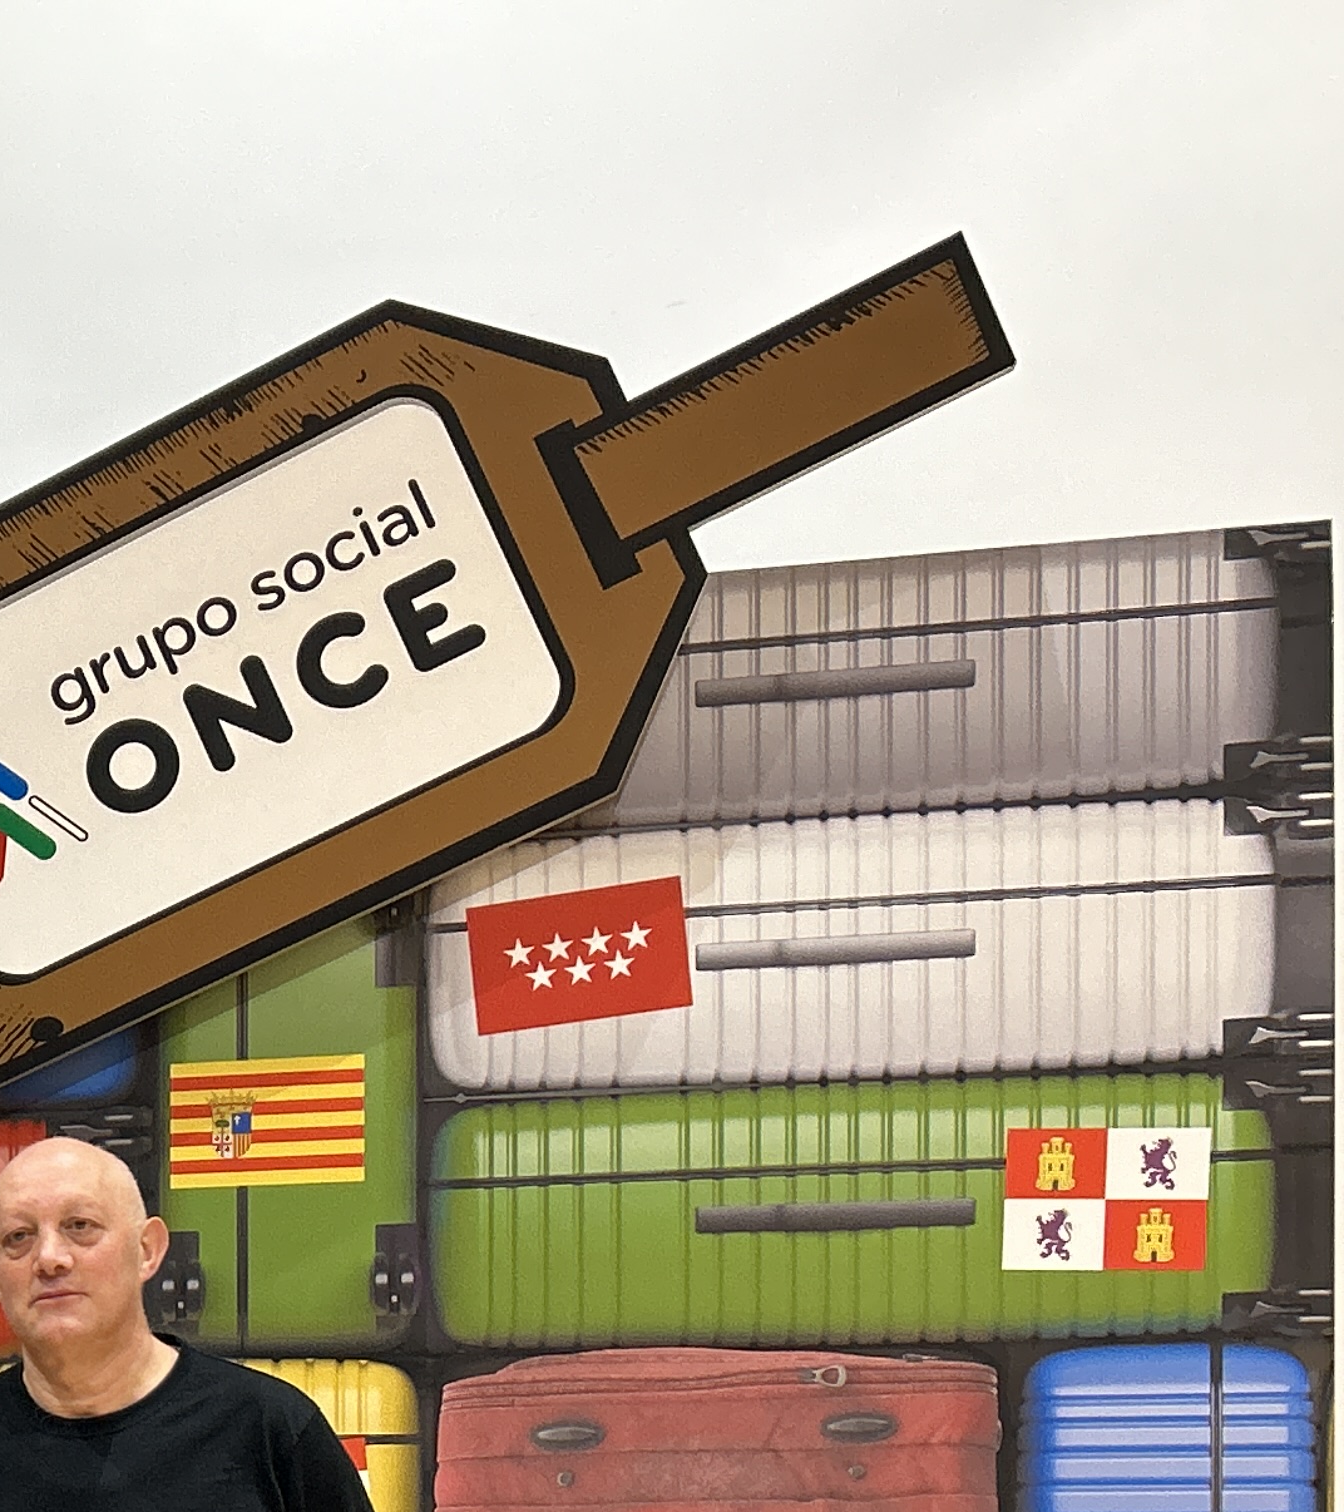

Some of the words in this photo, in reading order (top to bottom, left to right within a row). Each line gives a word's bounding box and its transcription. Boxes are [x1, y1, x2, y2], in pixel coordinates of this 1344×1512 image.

[50, 594, 238, 726] grupo
[250, 478, 437, 613] social
[85, 557, 487, 815] ONCE
